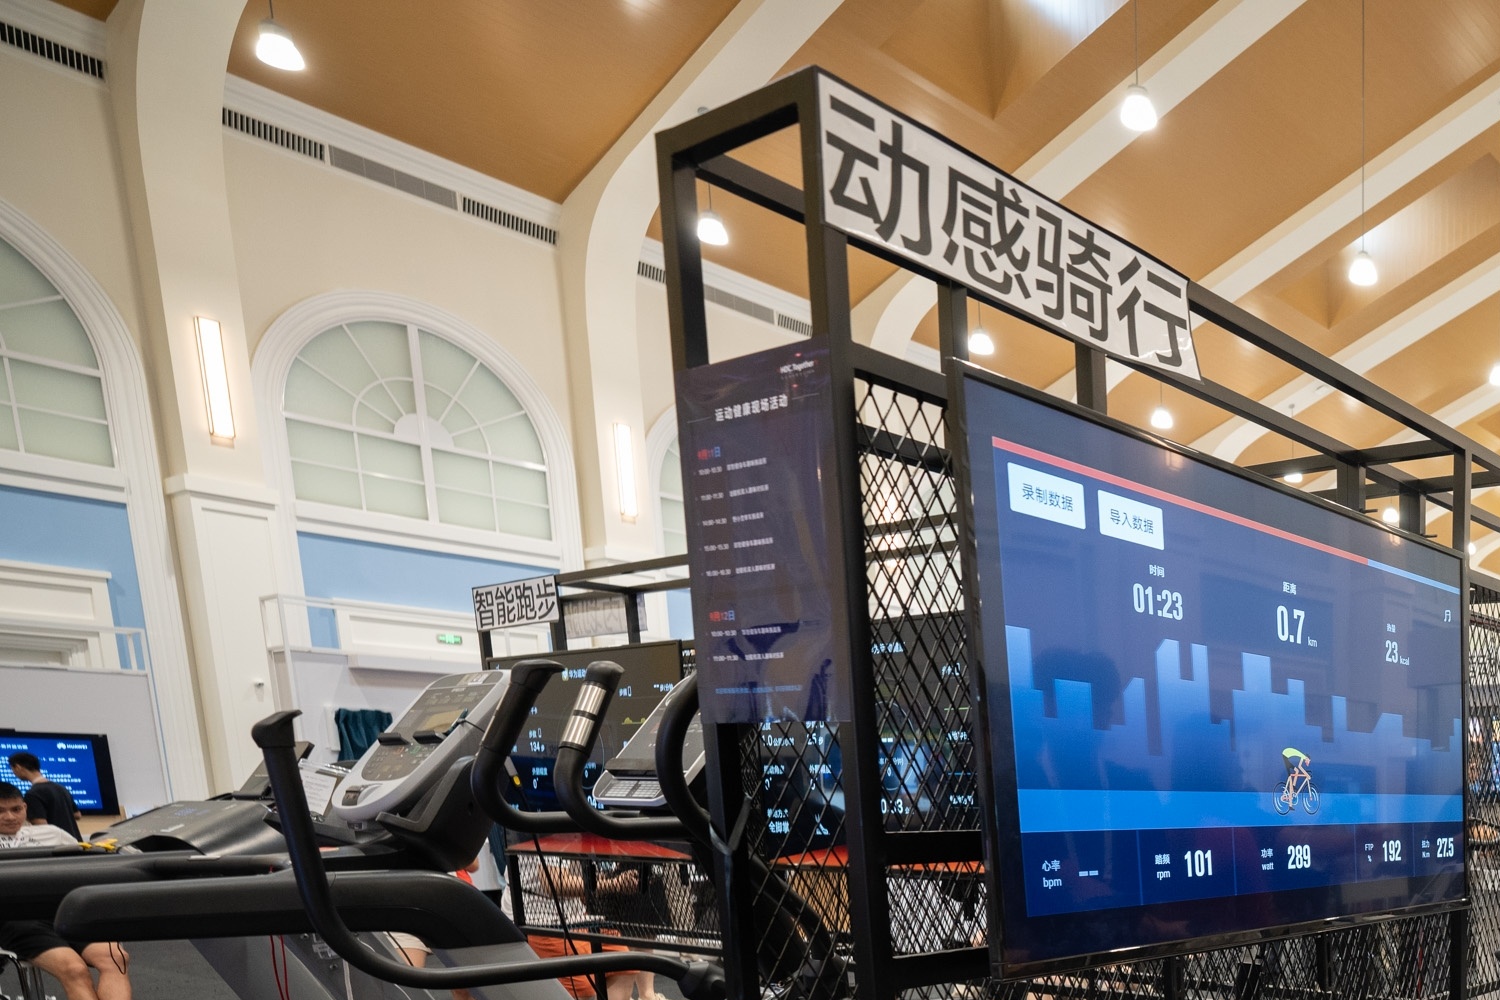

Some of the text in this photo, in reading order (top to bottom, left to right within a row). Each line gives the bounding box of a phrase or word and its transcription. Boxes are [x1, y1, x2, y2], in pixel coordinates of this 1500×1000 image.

[825, 93, 1188, 368] 动感骑行
[714, 393, 789, 422] 运动健康现场活动
[1022, 483, 1073, 512] 录制数据
[1110, 508, 1154, 534] 导入数据
[1149, 564, 1165, 578] 时间
[1282, 581, 1297, 595] 距离
[475, 579, 556, 628] 智能跑步
[1133, 583, 1184, 620] 01:23
[1276, 605, 1318, 648] 0.7 km
[1385, 640, 1398, 664] 23
[1261, 848, 1273, 859] 功率
[1287, 844, 1311, 870] 289
[1382, 840, 1402, 862] 192
[1436, 837, 1454, 857] 27.5
[1042, 860, 1061, 872] 心率
[1155, 853, 1171, 865] 踏频
[1184, 850, 1213, 877] 101
[1262, 862, 1274, 871] watt
[1043, 877, 1062, 889] bpm
[1156, 870, 1171, 880] rpm
